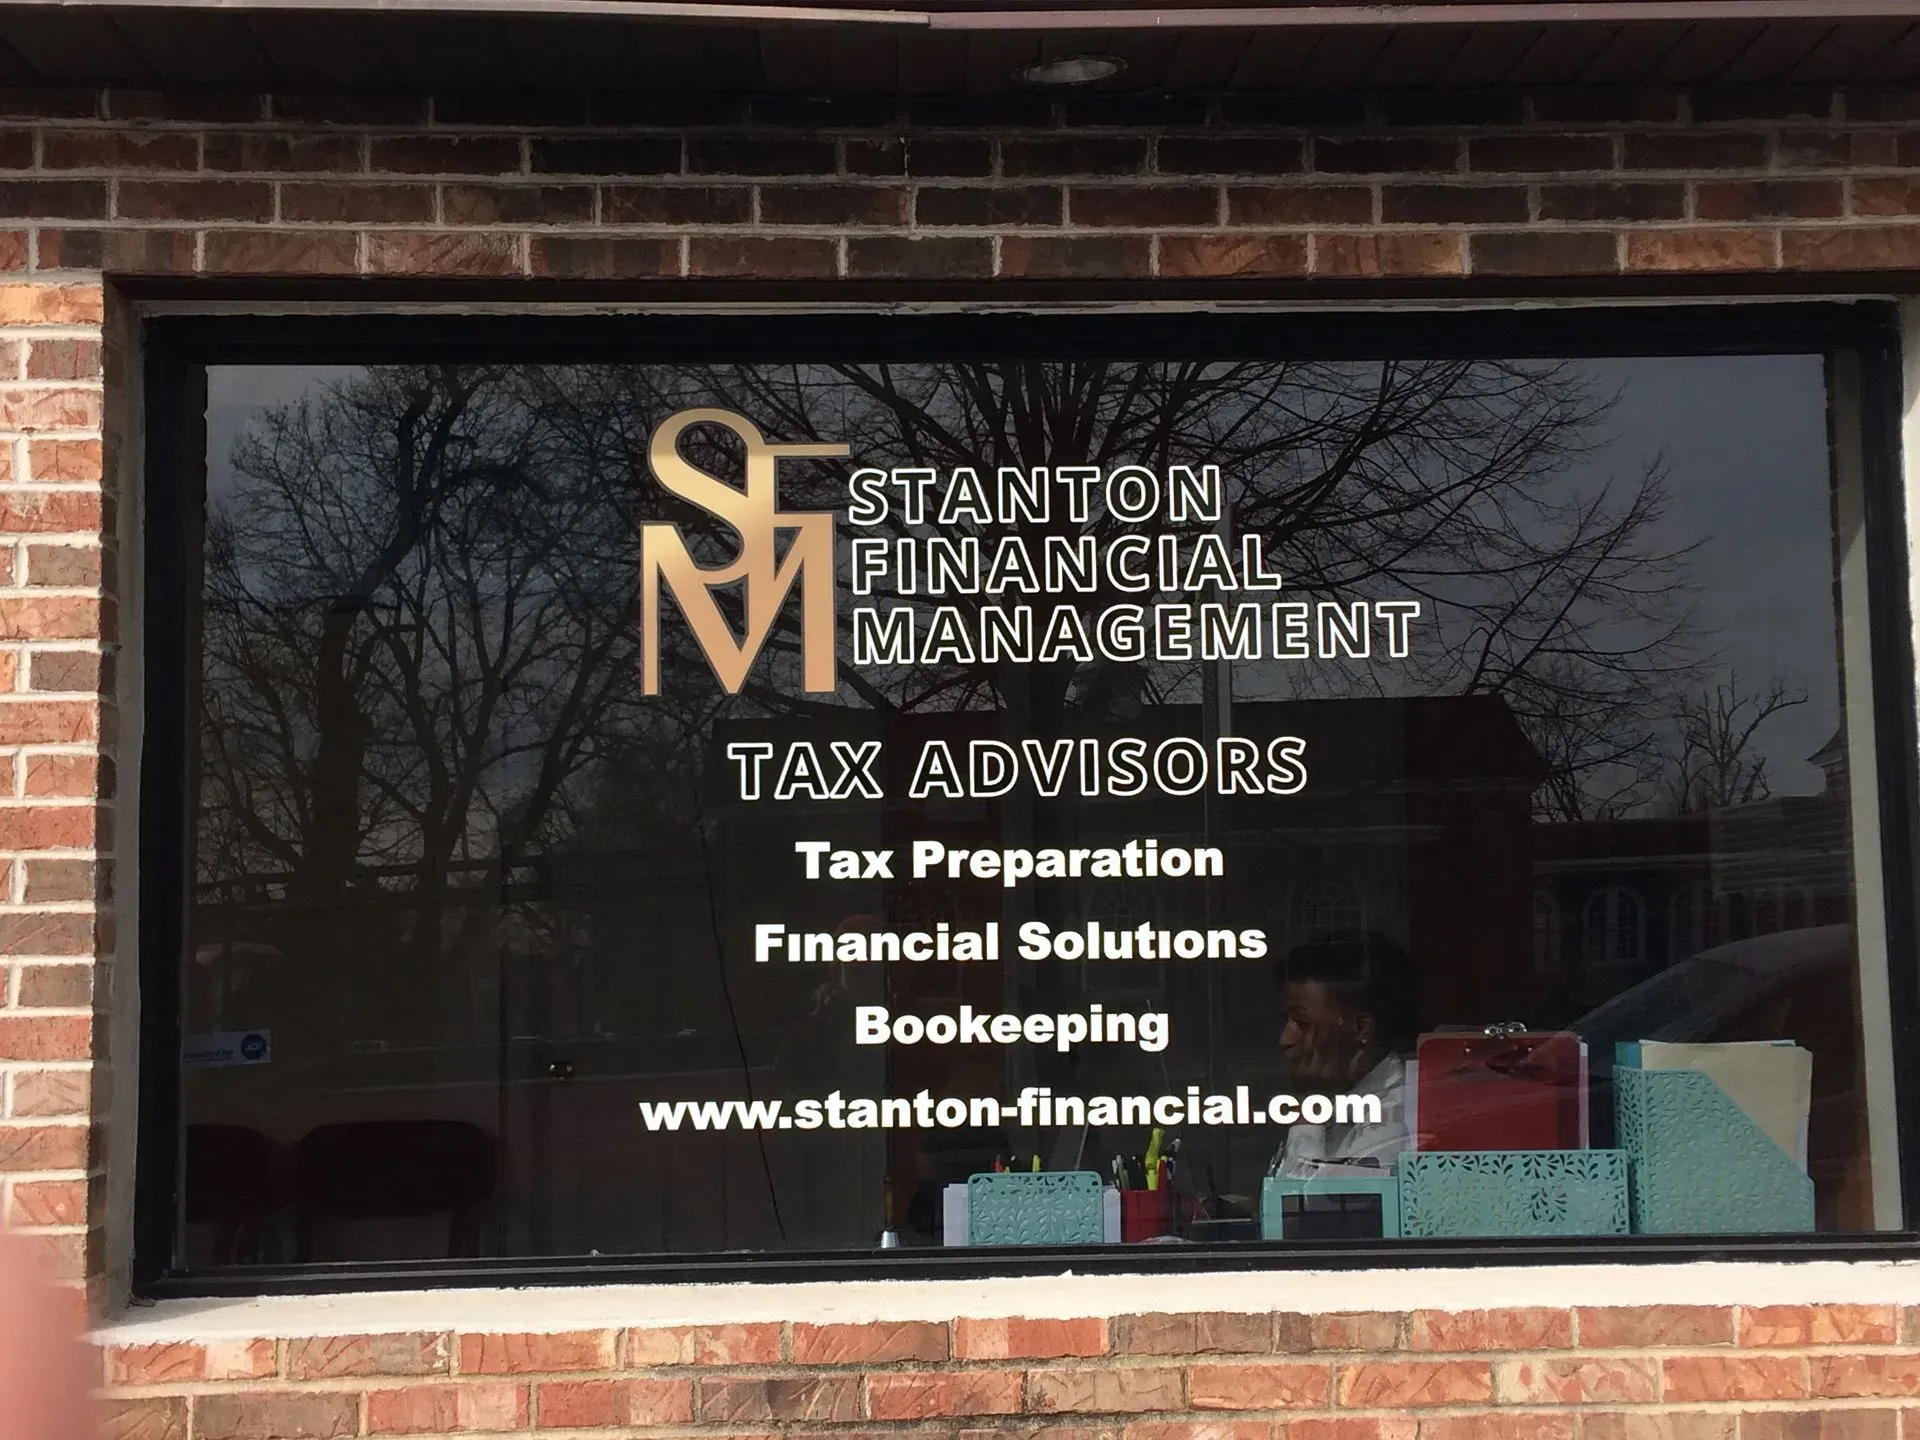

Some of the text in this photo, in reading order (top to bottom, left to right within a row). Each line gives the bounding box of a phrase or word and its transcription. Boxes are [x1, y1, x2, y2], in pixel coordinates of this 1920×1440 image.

[848, 464, 1221, 526] STANTON
[851, 533, 1282, 596] FINANCIAL
[853, 601, 1421, 665] MANAGEMENT
[727, 736, 1308, 801] TAX ADVISORS
[795, 839, 1224, 888] Tax Preparation
[855, 1004, 1170, 1053] Bookeeping
[639, 1085, 1382, 1132] www.stanton-financial.com
